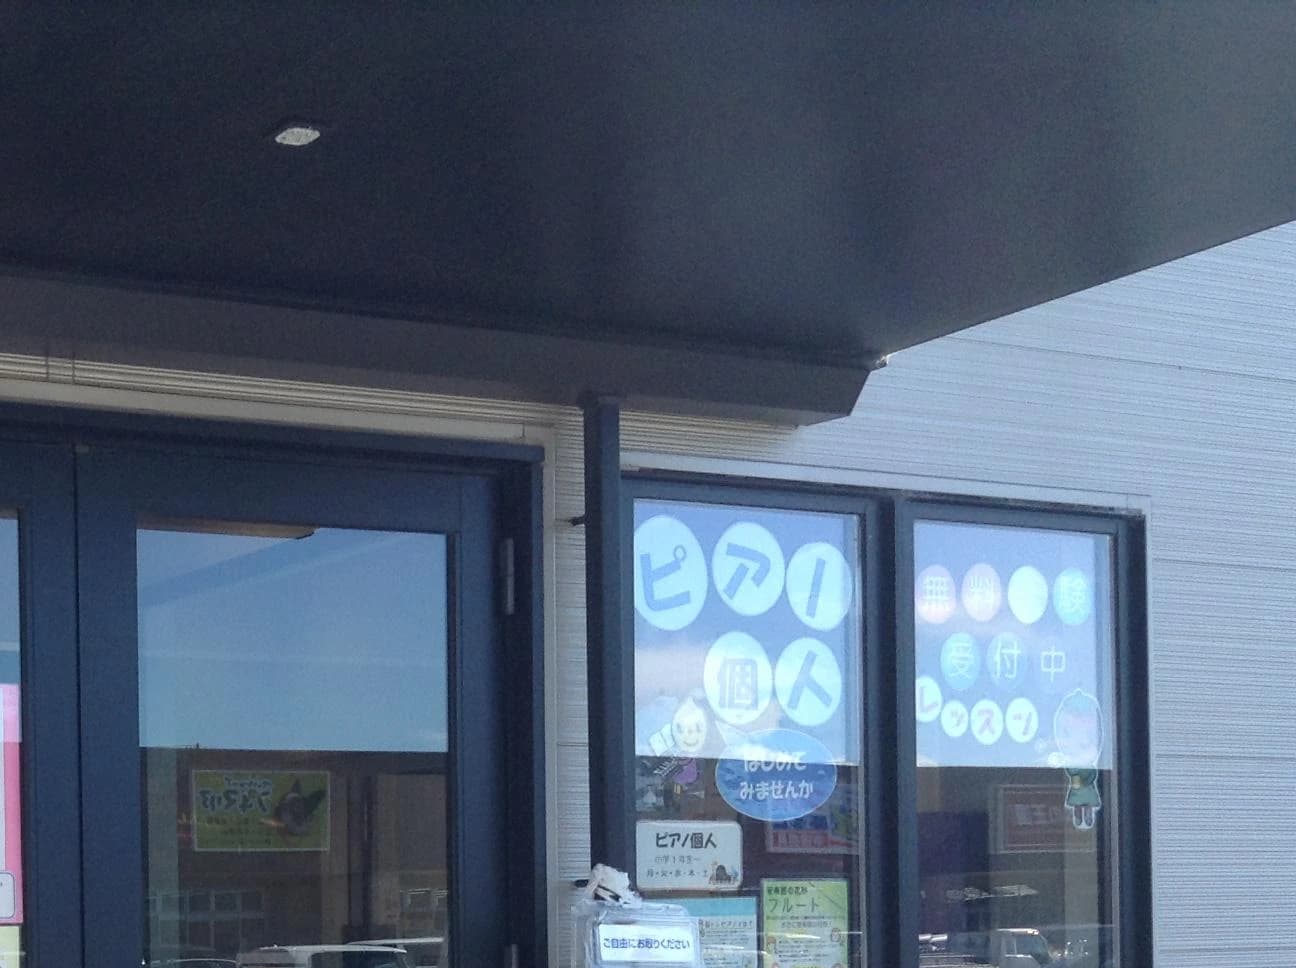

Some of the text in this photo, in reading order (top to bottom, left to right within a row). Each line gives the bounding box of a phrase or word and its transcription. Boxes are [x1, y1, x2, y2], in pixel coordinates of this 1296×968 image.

[639, 541, 826, 619] ピアノ
[950, 641, 1066, 683] 受付中
[718, 649, 833, 711] 個人
[739, 780, 813, 801] みませんか
[655, 832, 718, 849] ピアノ個人
[768, 898, 819, 914] フルート
